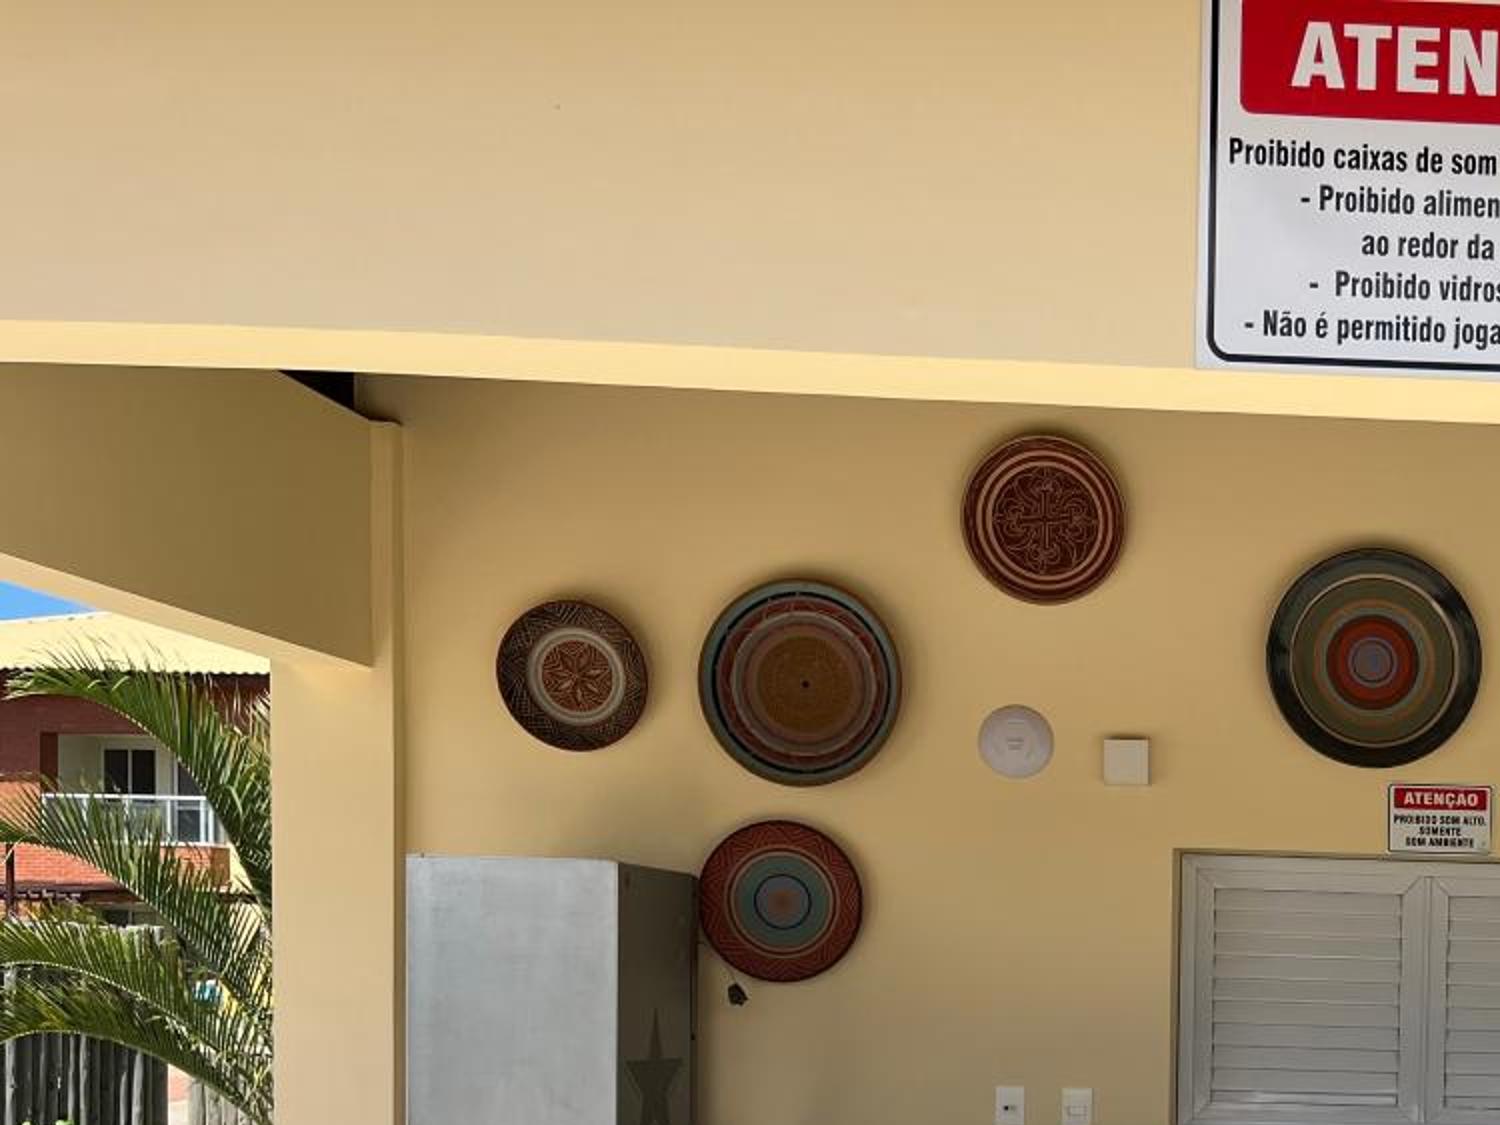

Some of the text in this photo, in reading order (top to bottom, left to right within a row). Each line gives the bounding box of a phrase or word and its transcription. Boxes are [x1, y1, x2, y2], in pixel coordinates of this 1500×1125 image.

[1229, 137, 1325, 169] Proibido
[1333, 144, 1408, 173] caixas
[1415, 145, 1443, 174] de
[1451, 153, 1497, 176] som
[1319, 184, 1415, 215] Proibido
[1361, 234, 1389, 257] ao
[1398, 231, 1459, 259] redor
[1467, 233, 1495, 260] da
[1335, 270, 1431, 301] Proibido
[1263, 309, 1307, 338] Não
[1315, 311, 1328, 339] é
[1337, 314, 1446, 345] permitido
[1393, 814, 1437, 825] PROIBIDO
[1419, 826, 1462, 836] SOMENTE
